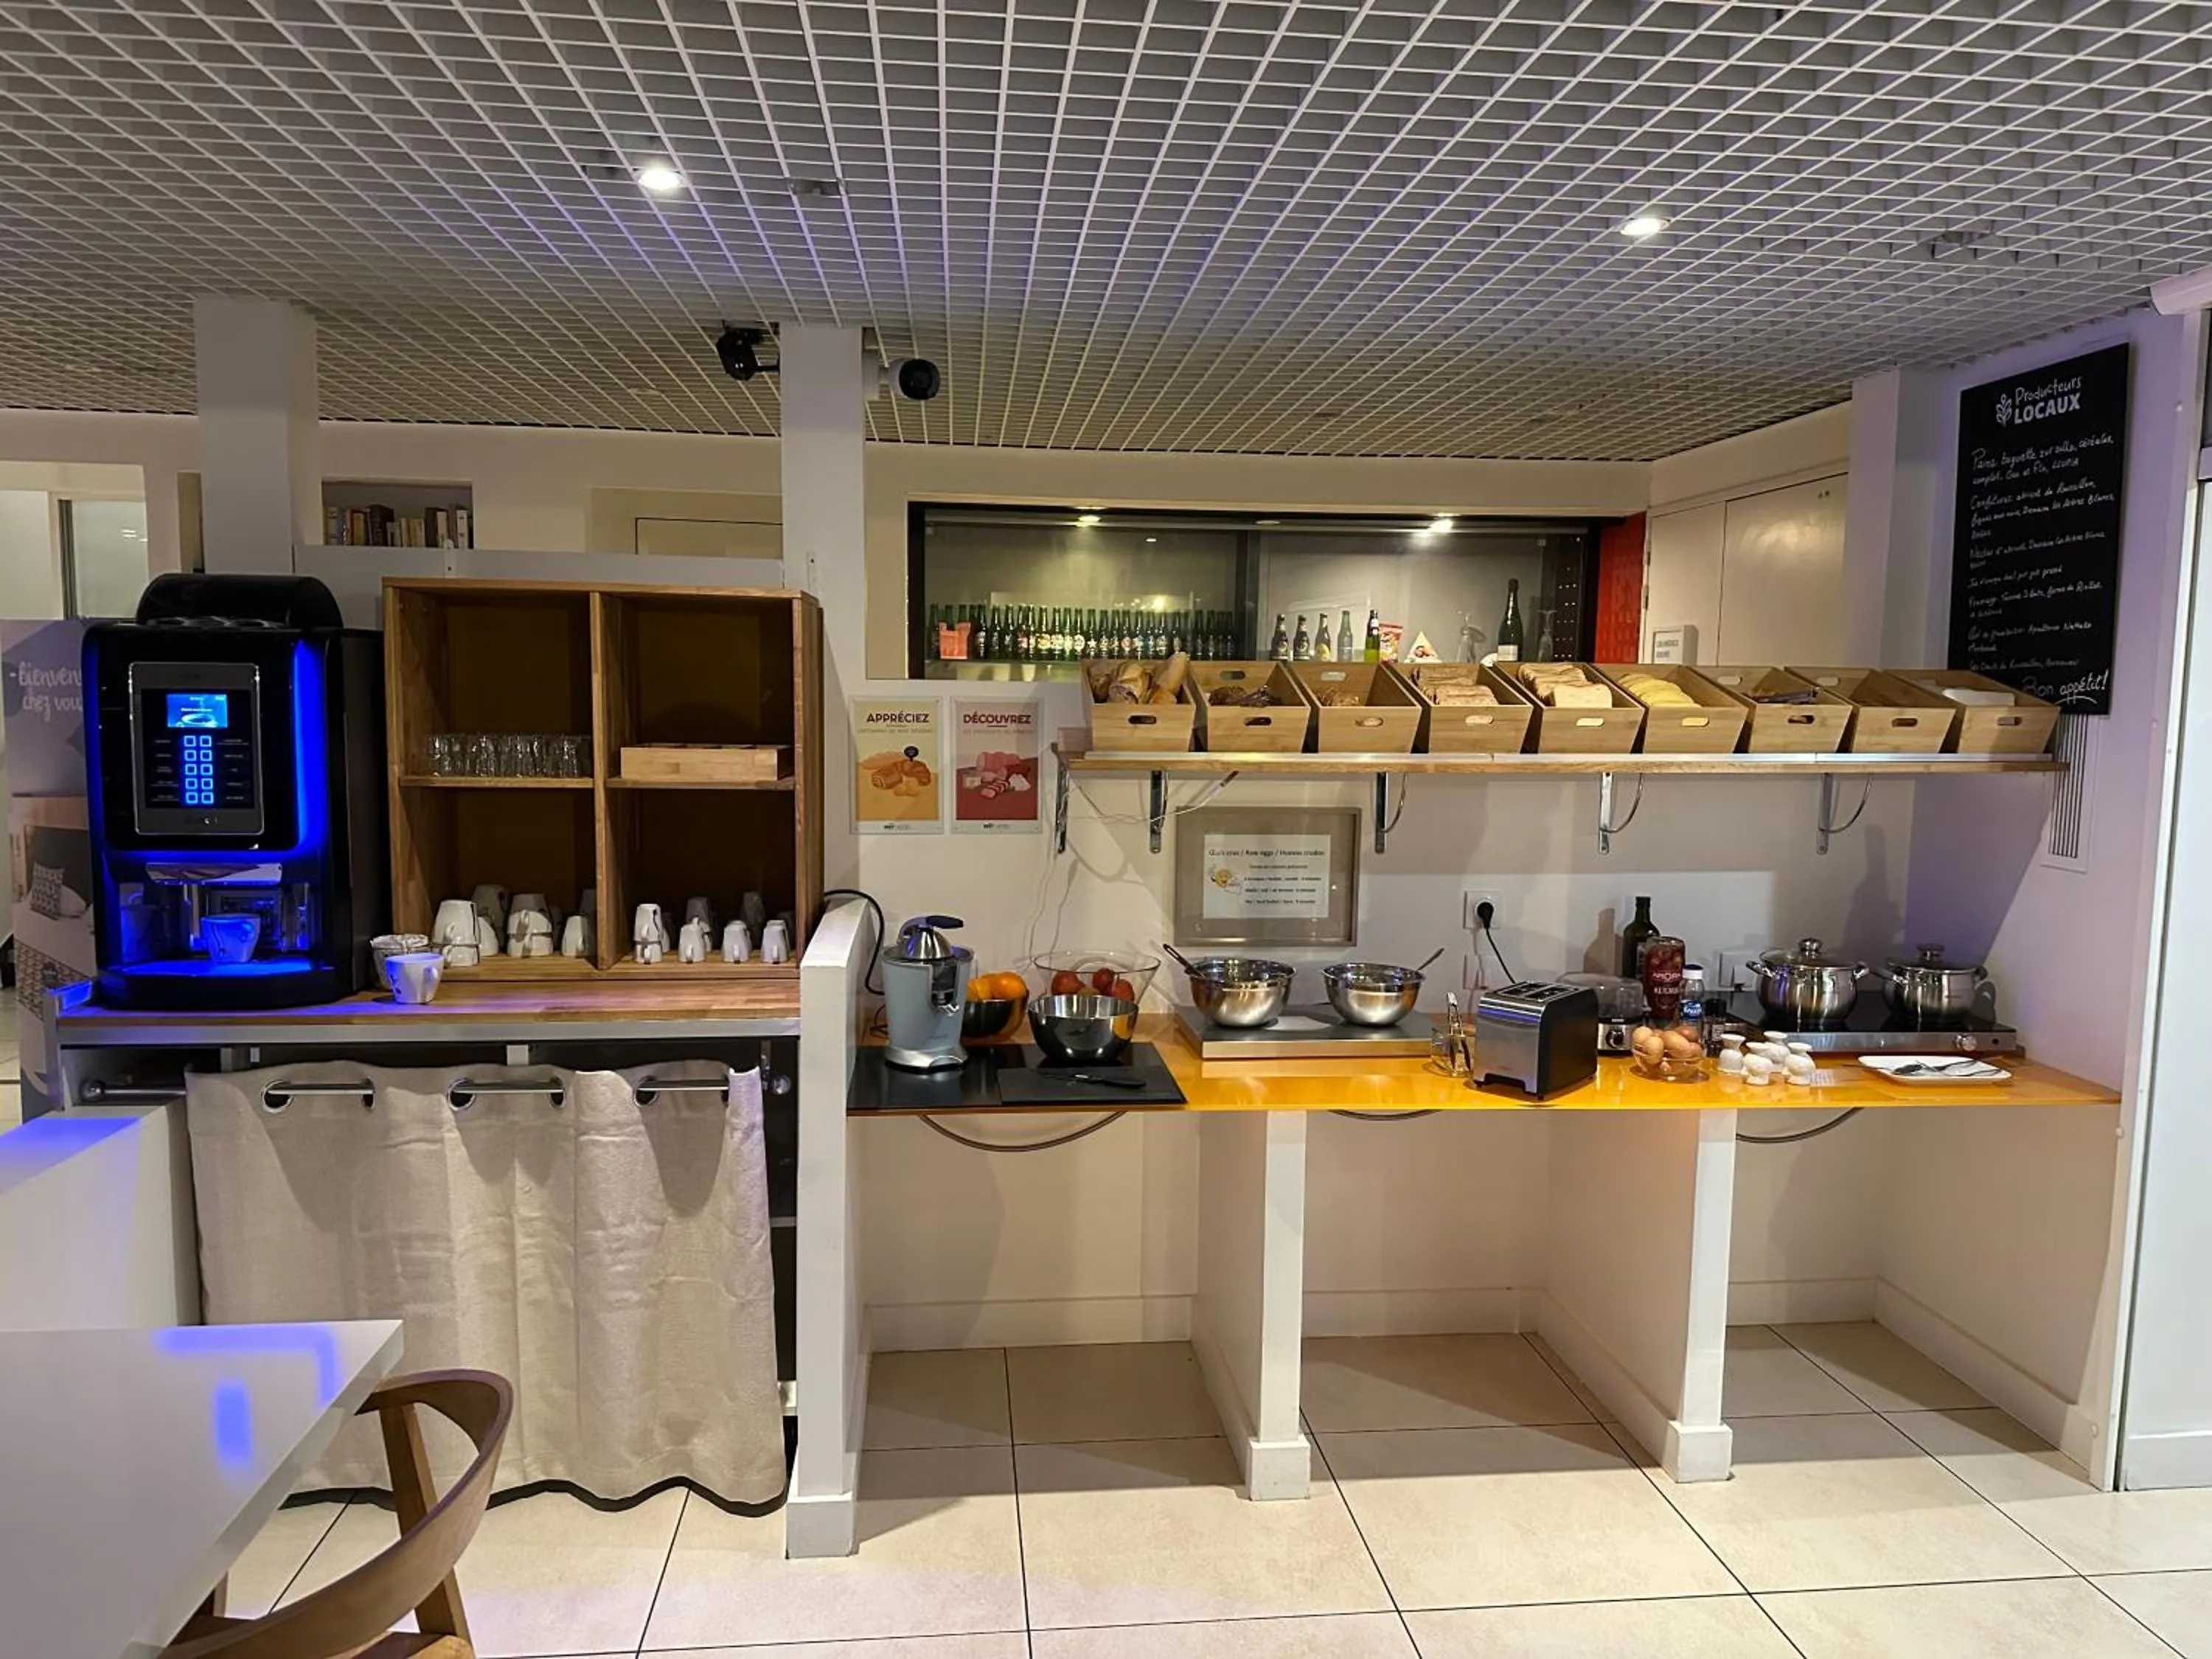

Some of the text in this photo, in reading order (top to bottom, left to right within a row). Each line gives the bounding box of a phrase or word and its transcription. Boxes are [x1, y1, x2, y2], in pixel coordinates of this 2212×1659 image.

[2015, 376, 2083, 406] Producteurs
[2014, 392, 2081, 425] LOCAUX
[18, 661, 82, 688] bienven
[866, 710, 930, 724] APPRÉCIEZ
[963, 711, 1032, 724] DÉCOUVREZ
